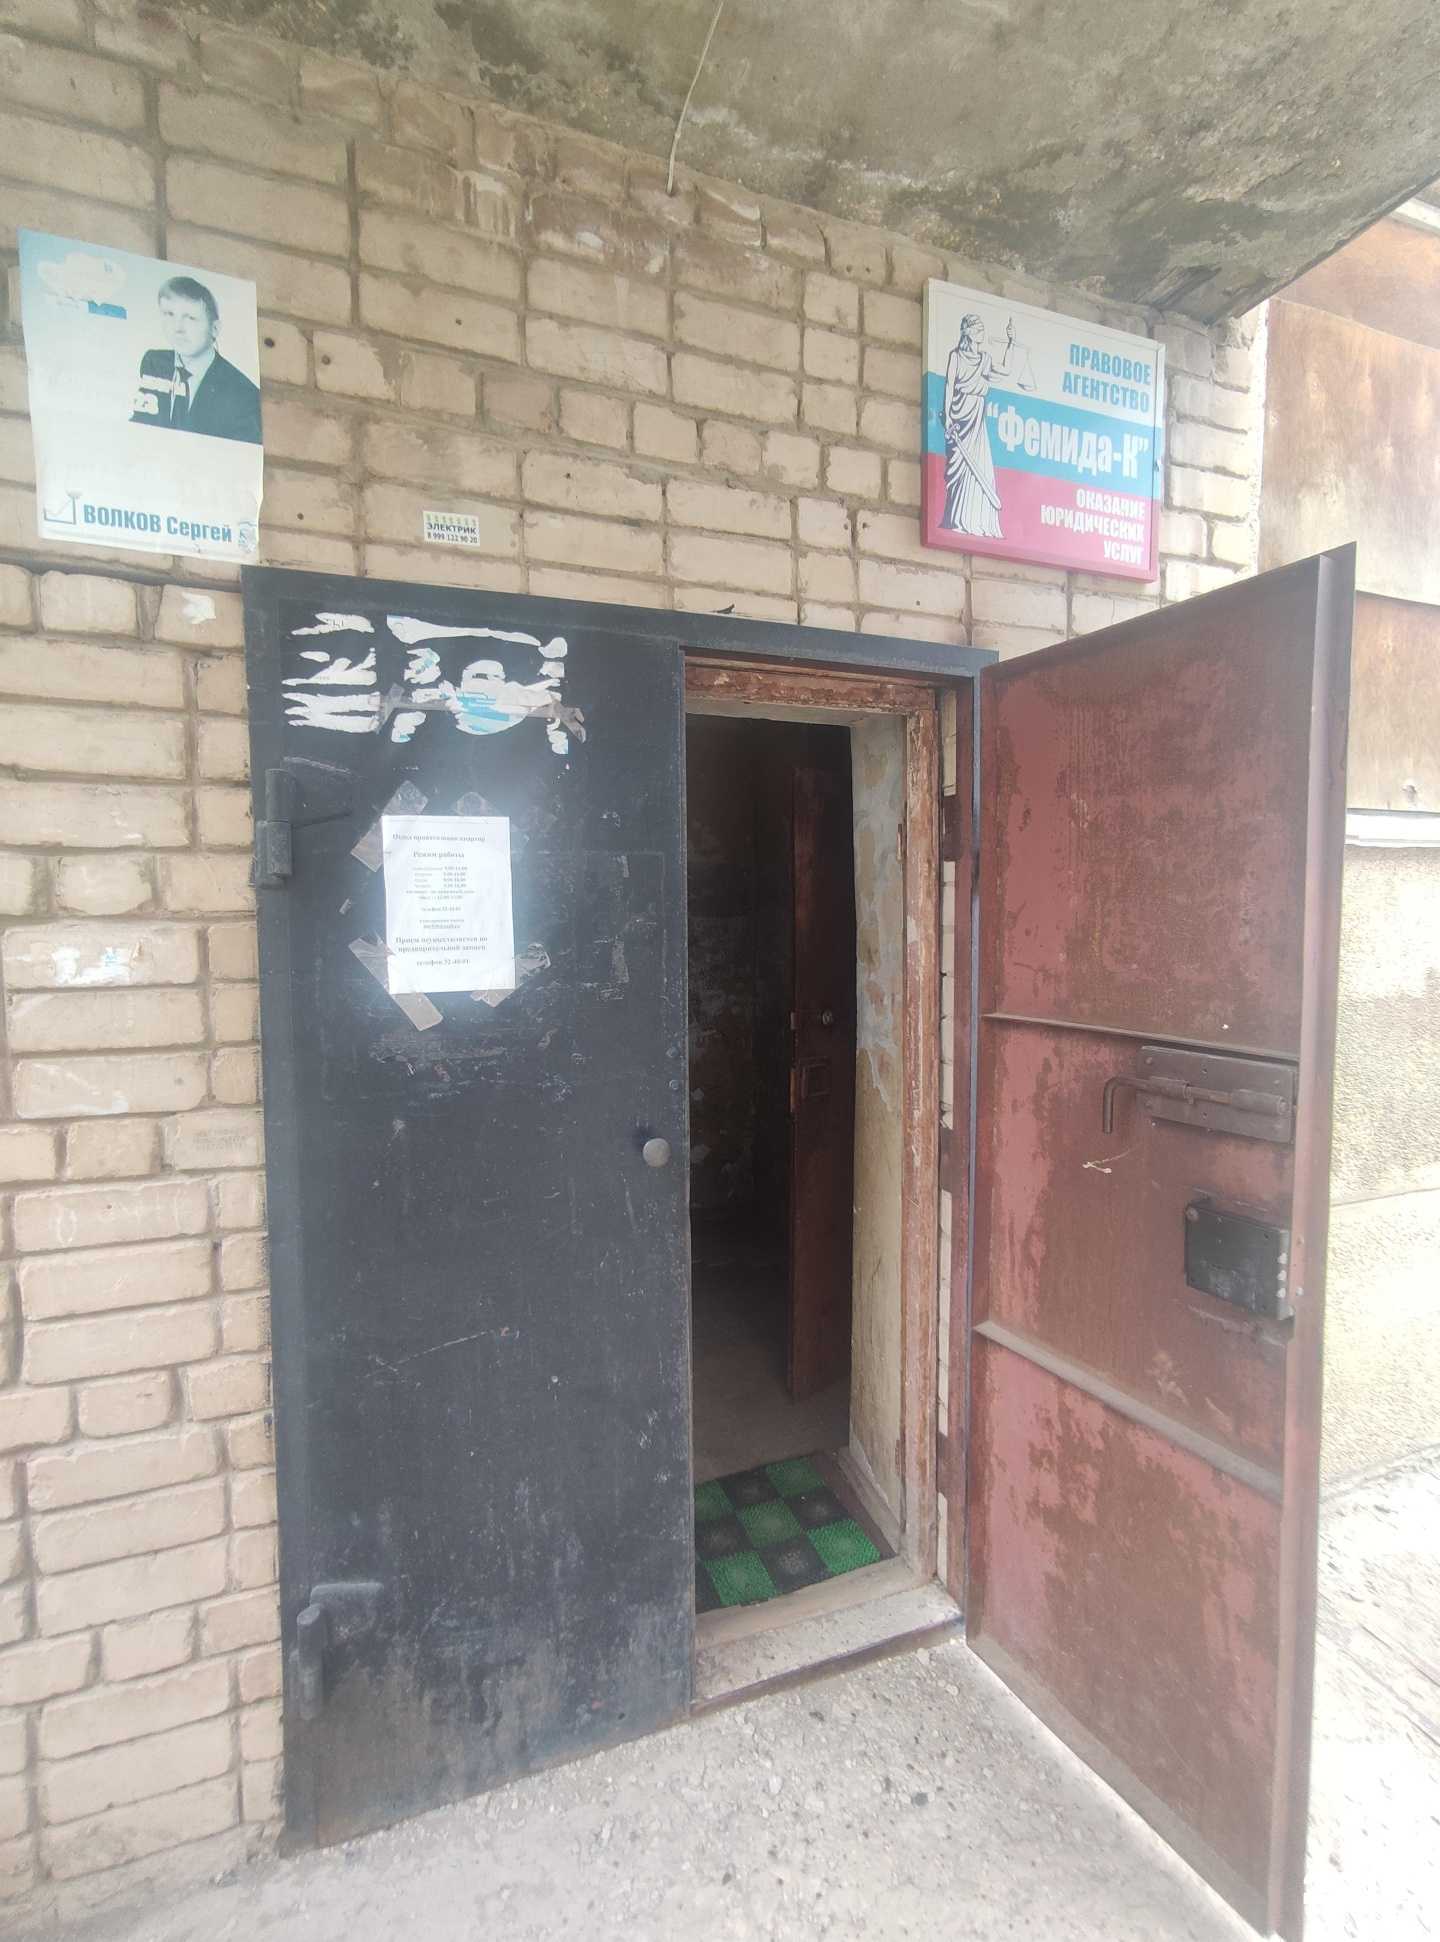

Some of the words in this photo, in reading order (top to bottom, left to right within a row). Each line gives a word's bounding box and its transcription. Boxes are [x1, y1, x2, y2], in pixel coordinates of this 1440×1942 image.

[1070, 344, 1151, 385] ПРАВОВОЕ
[1062, 372, 1149, 413] АГЕНТСТВО
[1076, 488, 1145, 517] ОКАЗАНИЕ
[83, 504, 161, 533] ВОЛКОВ
[167, 516, 232, 542] Сергей
[426, 522, 477, 535] ЭЛЕКТРИК
[1041, 505, 1145, 539] ЮРИДИЧЕСКИХ
[1104, 541, 1143, 565] УСЛУГ
